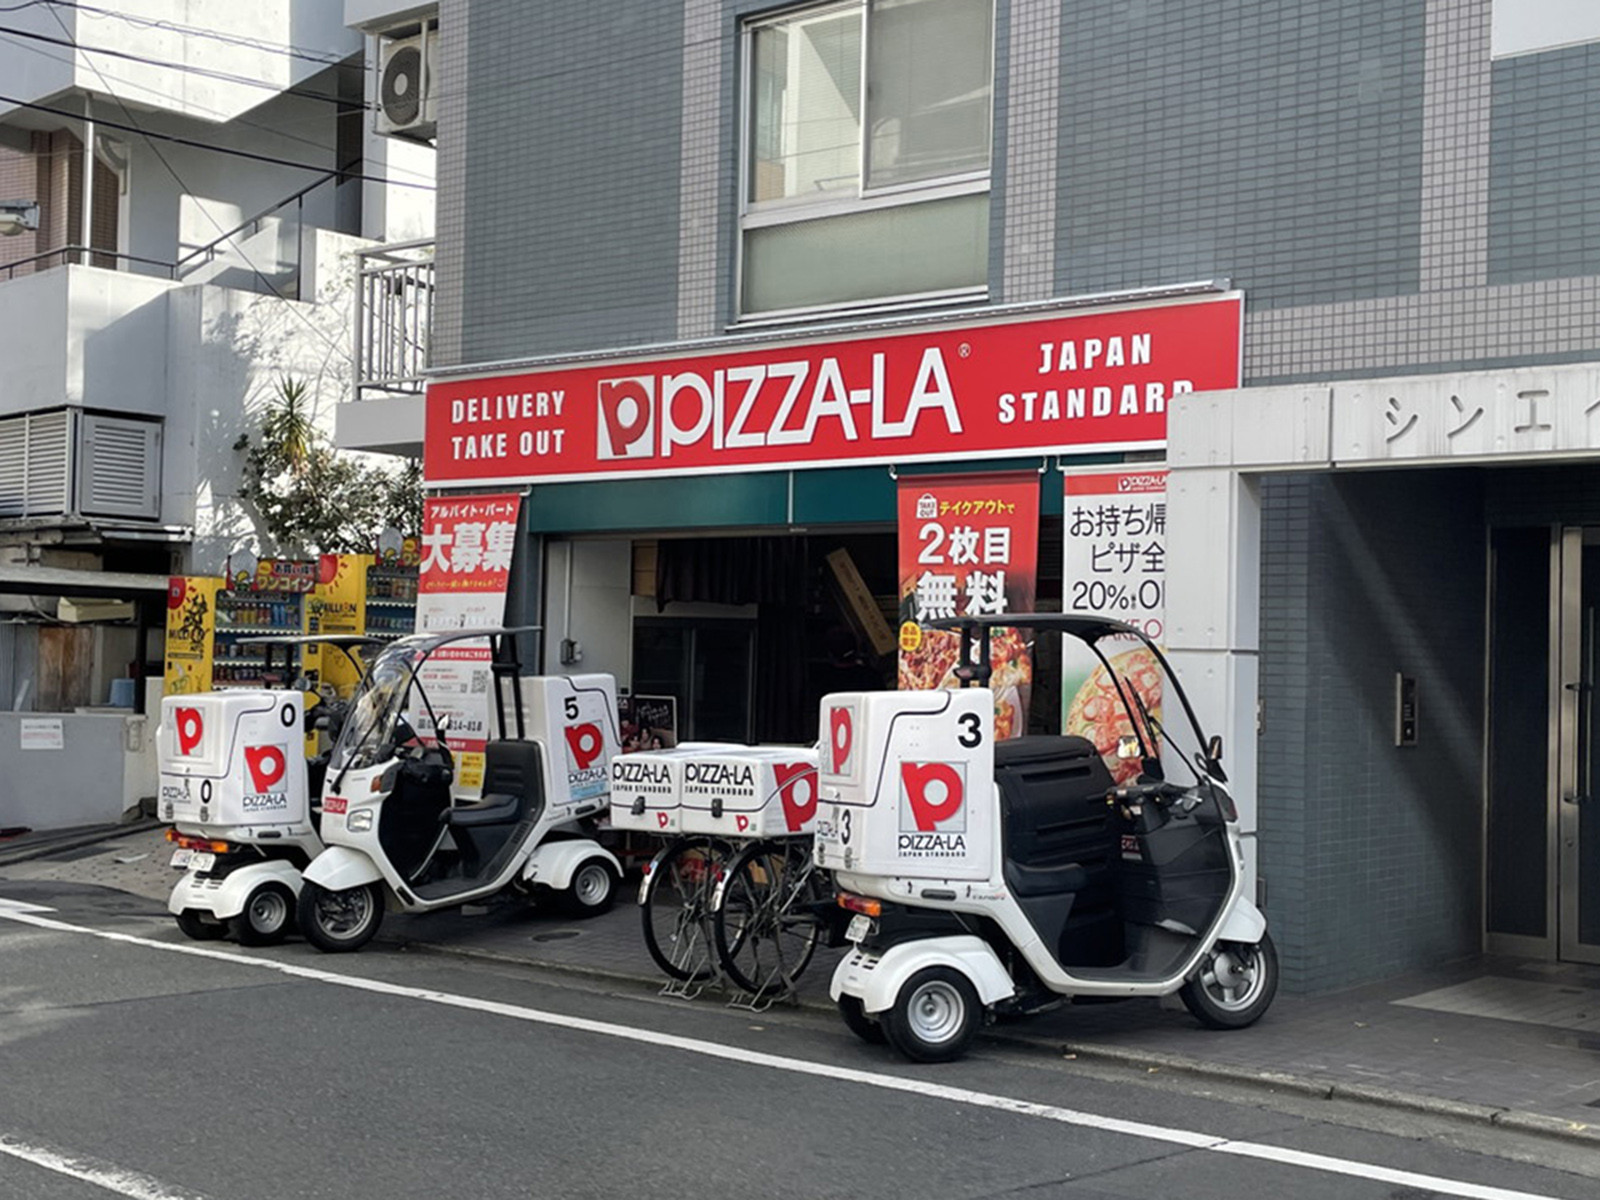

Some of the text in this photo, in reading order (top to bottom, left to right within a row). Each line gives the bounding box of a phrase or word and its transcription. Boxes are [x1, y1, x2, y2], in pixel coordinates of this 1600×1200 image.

[1038, 333, 1151, 374] JAPAN
[451, 390, 565, 423] DELIVERY
[451, 429, 565, 460] TAKE OUT
[939, 499, 1015, 516] テイクアウトで
[1070, 503, 1167, 537] お持ち帰
[419, 520, 517, 574] 大募集
[917, 522, 1011, 565] 2枚目
[1091, 541, 1166, 574] ピザ全
[915, 570, 1008, 621] 無料
[1072, 580, 1130, 611] 20%
[281, 702, 296, 728] 0
[564, 696, 579, 720] 5
[957, 712, 982, 749] 3
[200, 779, 213, 804] 0
[841, 808, 852, 846] 3
